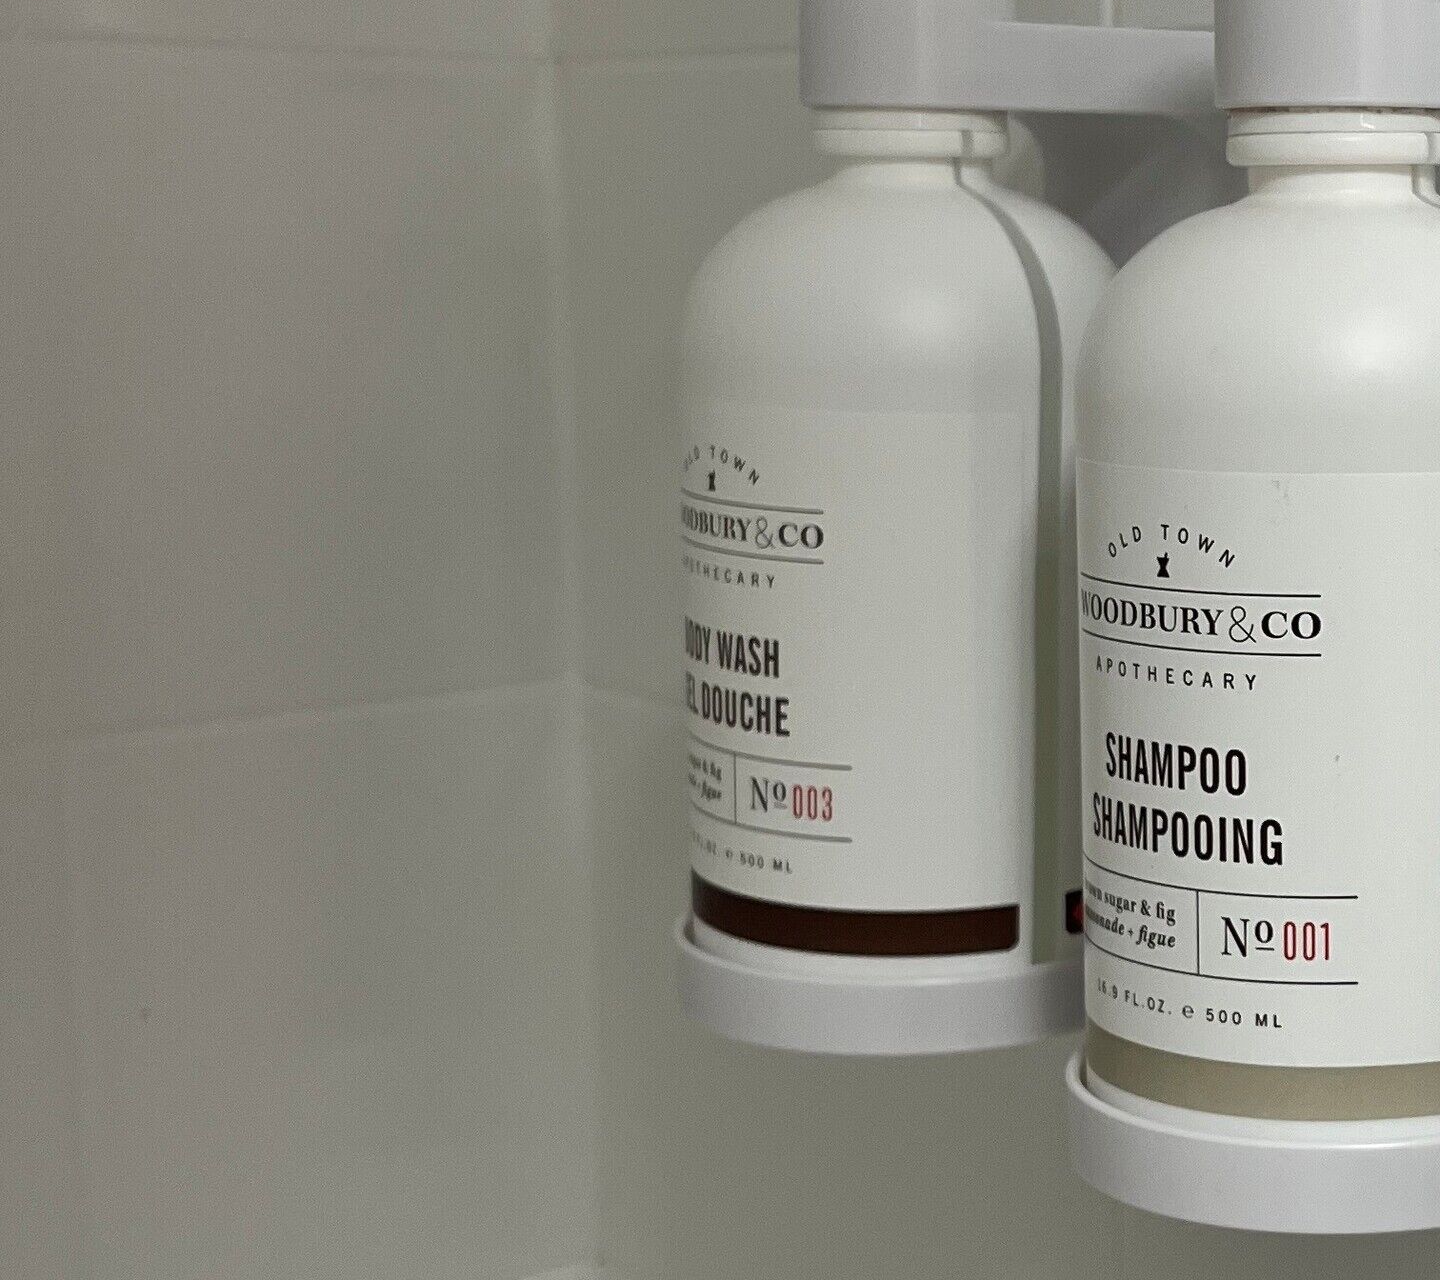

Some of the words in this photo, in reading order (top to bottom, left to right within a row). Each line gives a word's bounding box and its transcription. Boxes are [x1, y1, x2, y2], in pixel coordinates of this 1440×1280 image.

[707, 444, 760, 486] TOWN
[1108, 526, 1142, 558] OLD
[1160, 523, 1236, 568] TOWN
[717, 630, 780, 679] WASH
[1096, 655, 1257, 691] APOTHECARY
[702, 681, 791, 737] DOUCHE
[1105, 732, 1247, 796] SHAMPOO
[1093, 792, 1284, 866] SHAMPOOING
[773, 857, 793, 874] ML
[1104, 891, 1136, 914] sugar
[1141, 899, 1152, 918] &
[1156, 901, 1176, 927] fig
[1136, 924, 1176, 950] figue
[1206, 1008, 1242, 1026] 500
[1255, 1013, 1283, 1028] ML
